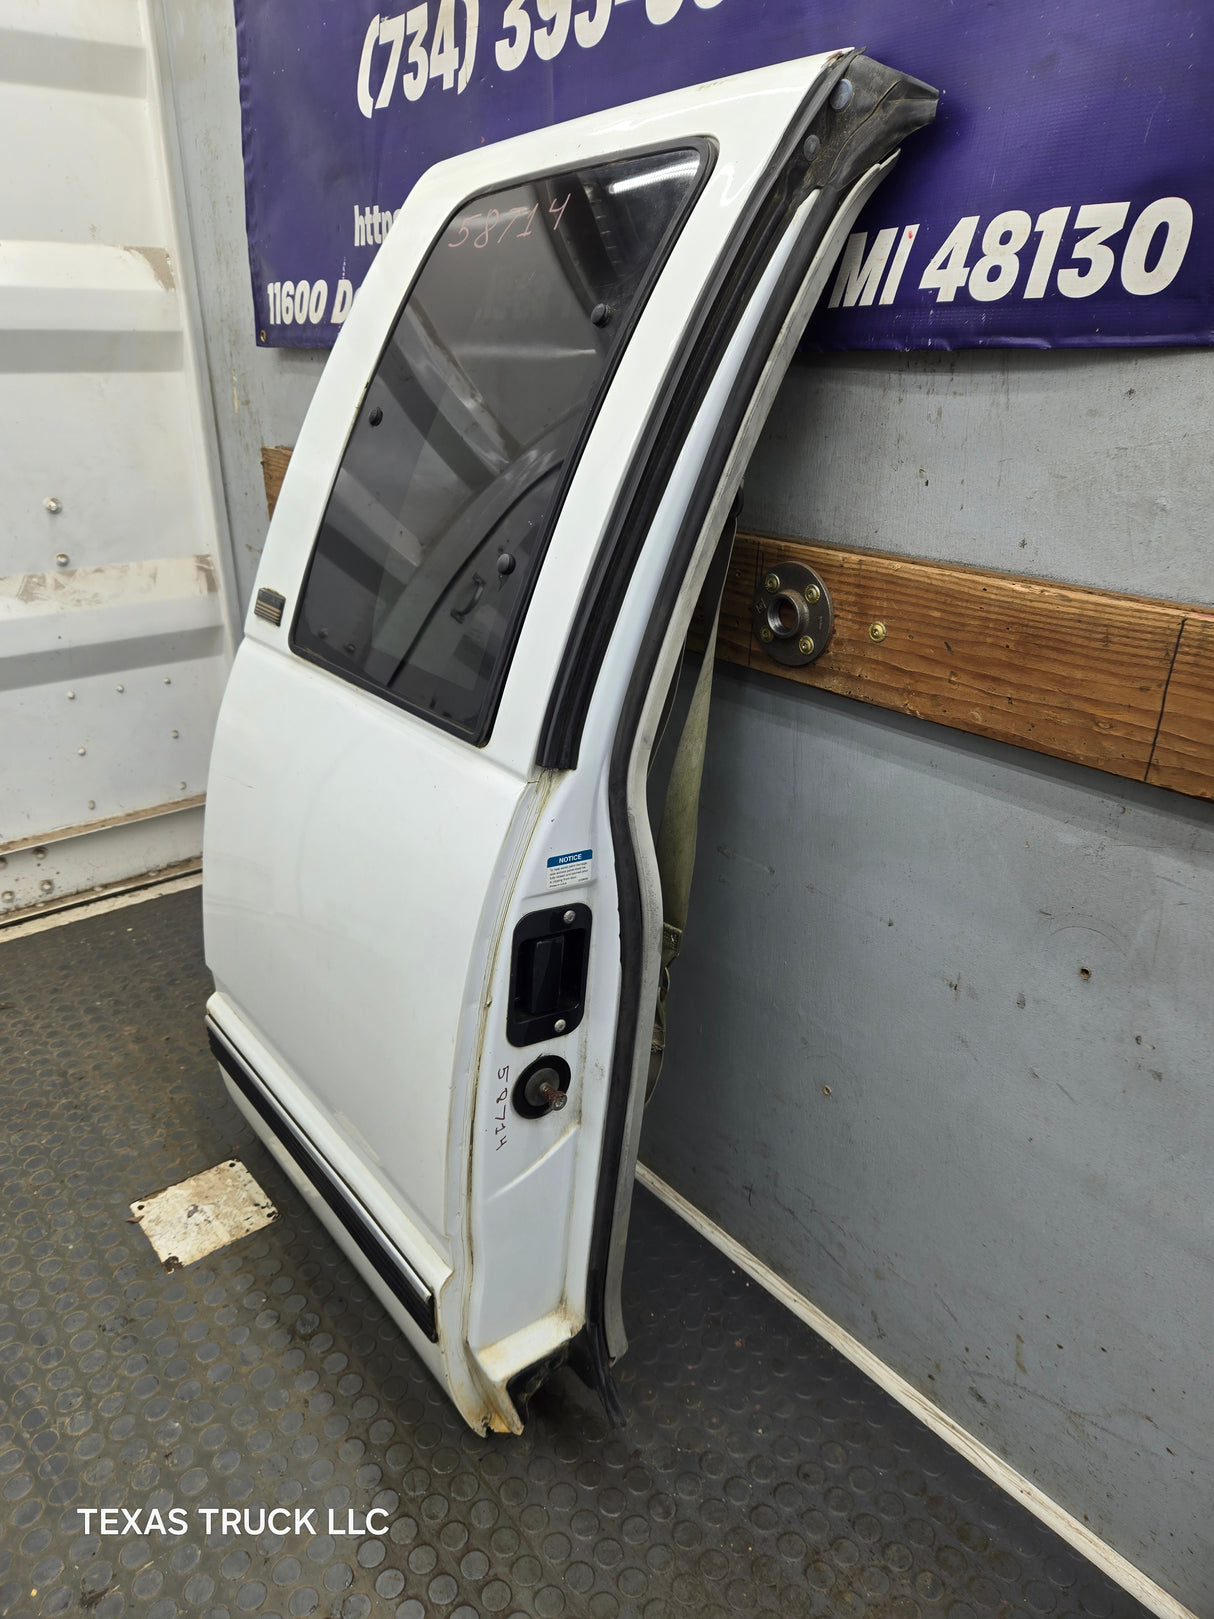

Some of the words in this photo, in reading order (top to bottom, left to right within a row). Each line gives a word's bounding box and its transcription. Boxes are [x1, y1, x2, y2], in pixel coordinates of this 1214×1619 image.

[357, 0, 480, 119] (734)
[447, 192, 572, 249] 58714
[827, 223, 920, 309] MI
[918, 196, 1194, 303] 48130
[267, 279, 328, 325] 11600
[331, 279, 361, 323] D
[558, 853, 583, 864] NOTICE
